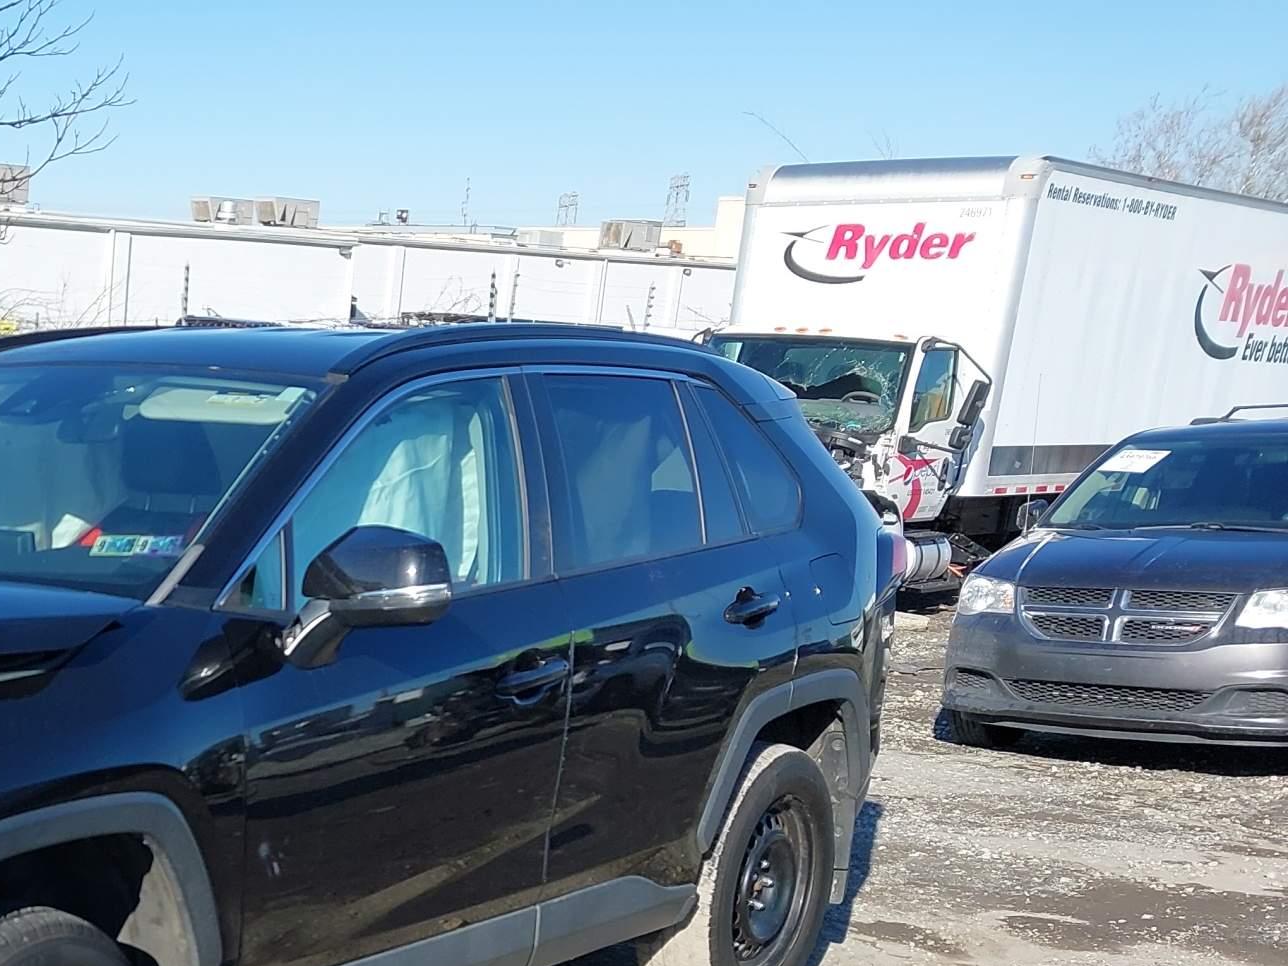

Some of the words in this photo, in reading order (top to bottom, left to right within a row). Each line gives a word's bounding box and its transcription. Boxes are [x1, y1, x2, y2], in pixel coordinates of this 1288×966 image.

[1047, 183, 1073, 202] Rental
[1072, 187, 1121, 211] Reservations:
[1121, 196, 1177, 221] 1-800-BY-RYDER
[825, 221, 977, 270] Ryder
[1218, 263, 1288, 338] Ryde
[1241, 333, 1268, 362] Ever
[1266, 335, 1288, 364] bett
